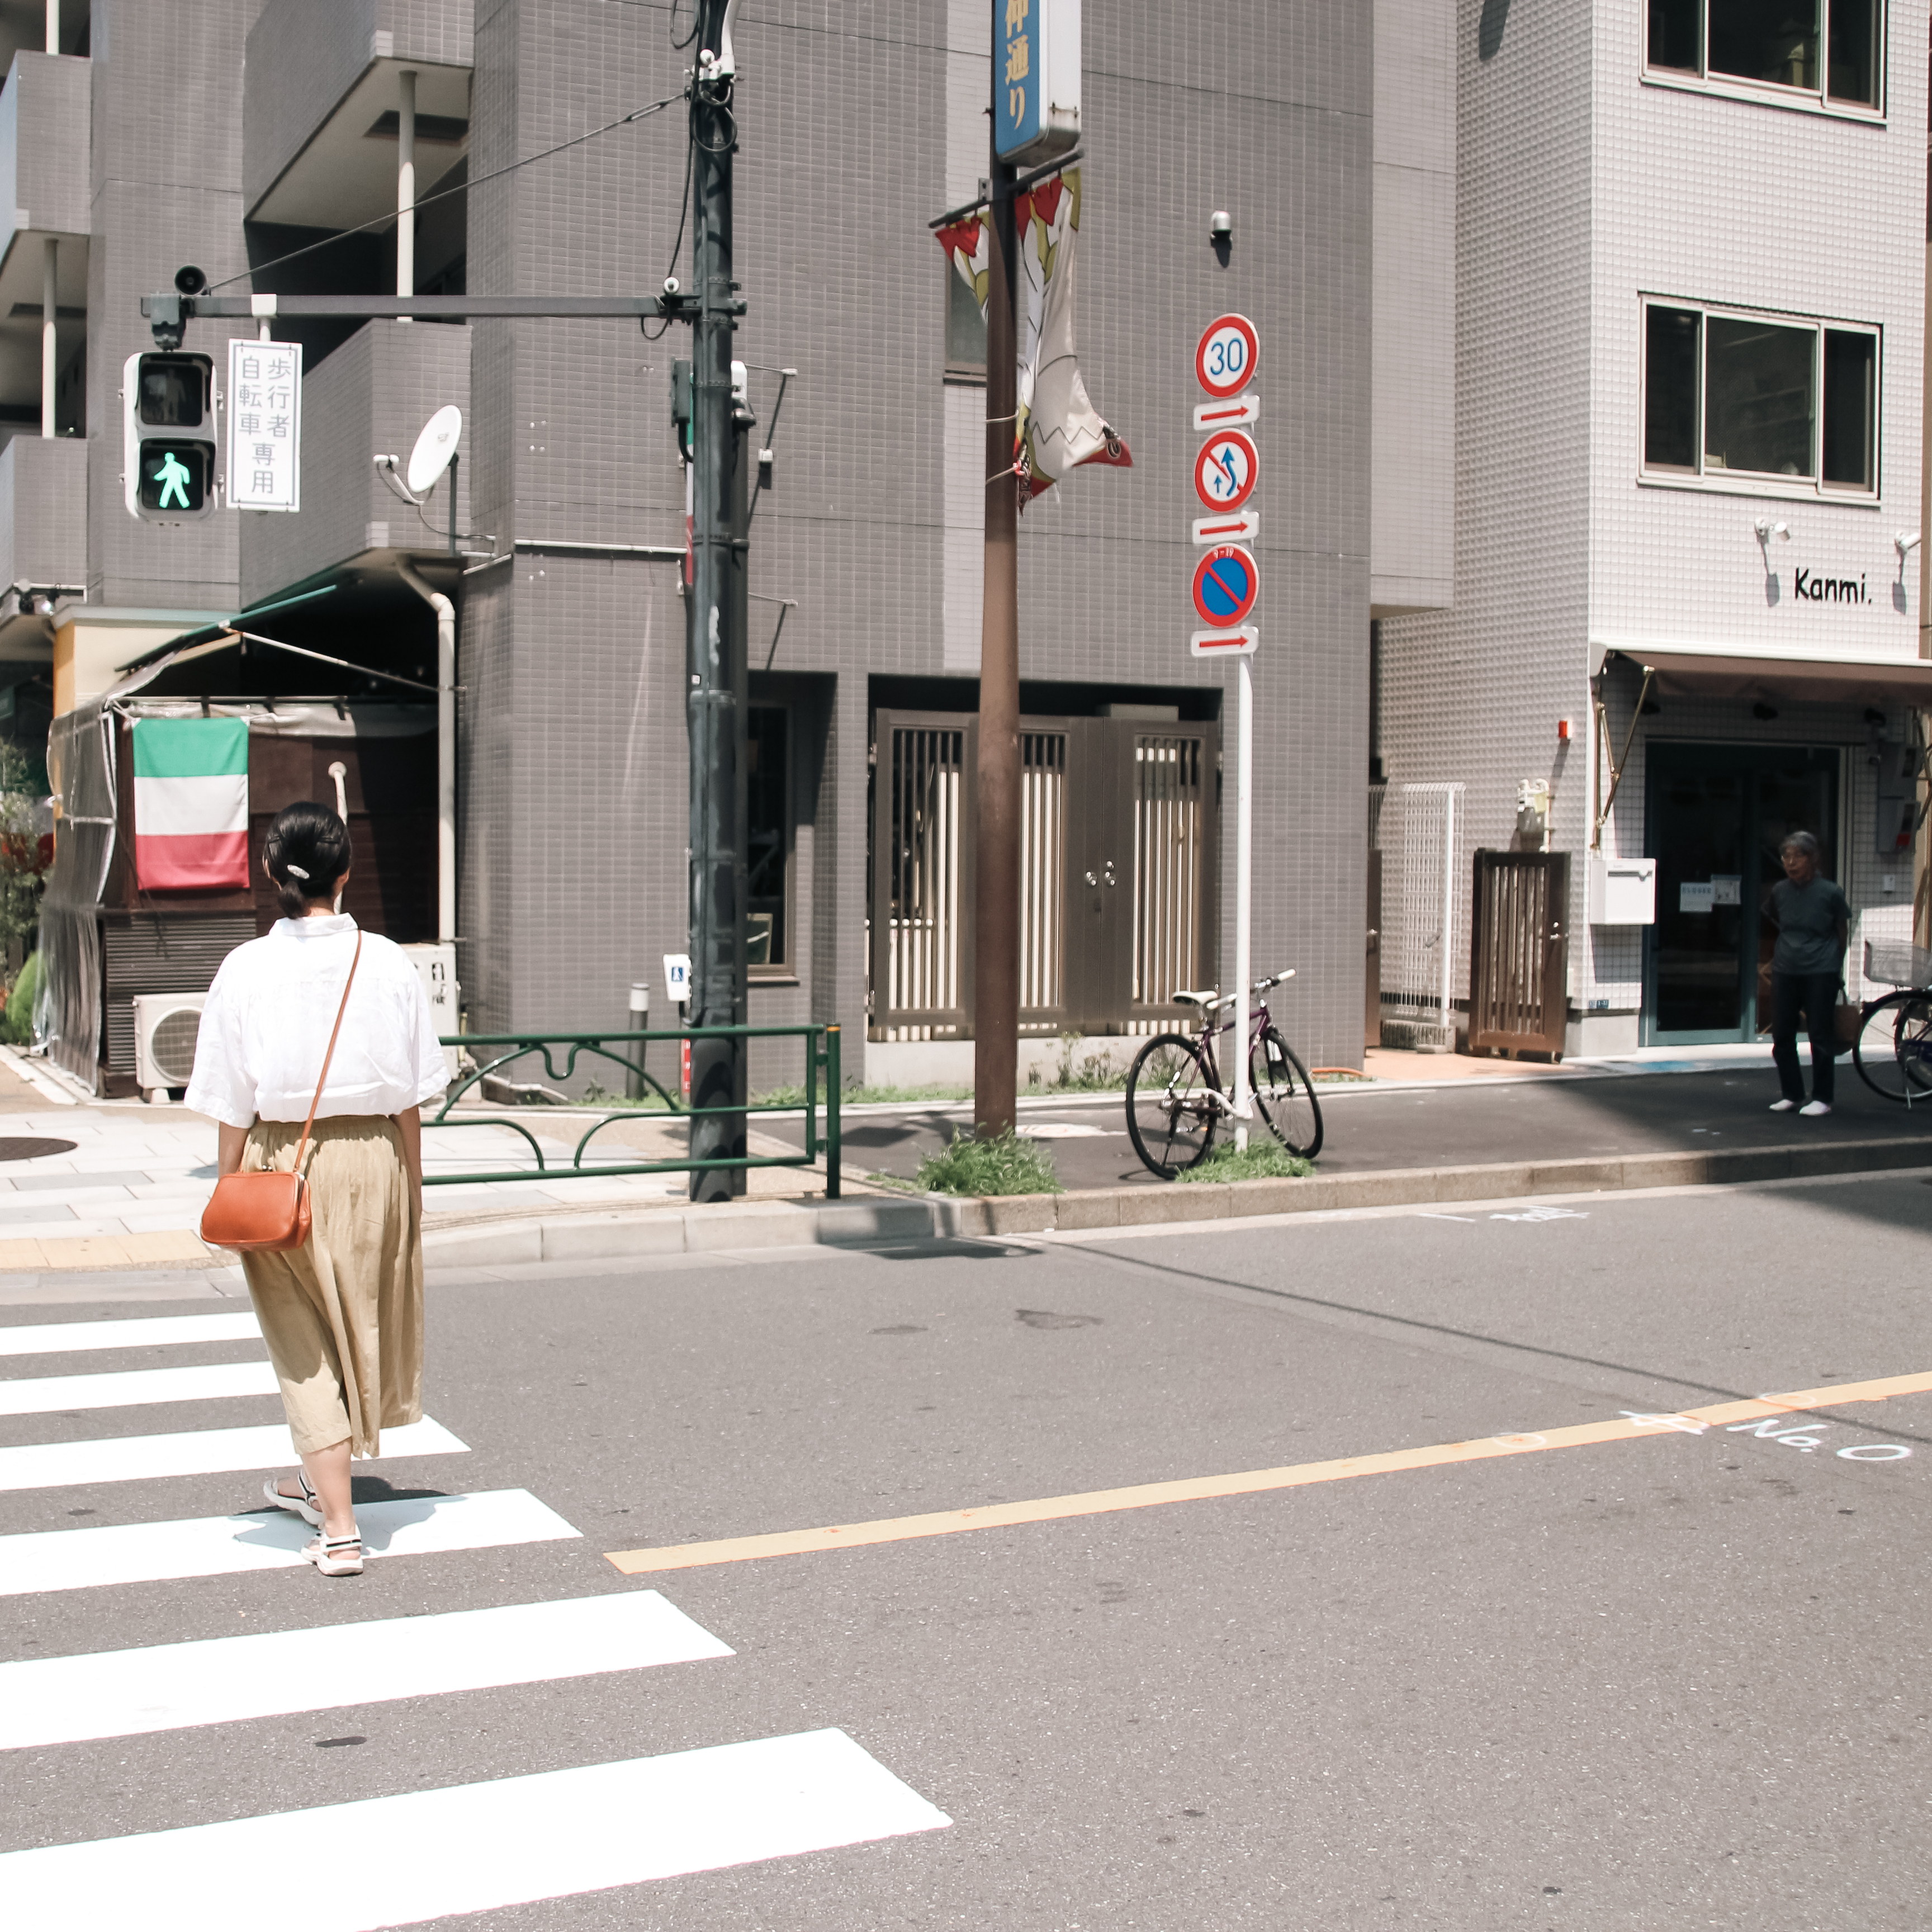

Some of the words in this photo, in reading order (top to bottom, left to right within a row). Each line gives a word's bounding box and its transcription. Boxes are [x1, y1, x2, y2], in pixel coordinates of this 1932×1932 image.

[1210, 337, 1244, 376] 30
[239, 355, 262, 435] 自転車
[267, 357, 291, 438] 歩行者
[252, 442, 276, 494] 専用
[1795, 567, 1872, 605] Kanmi.
